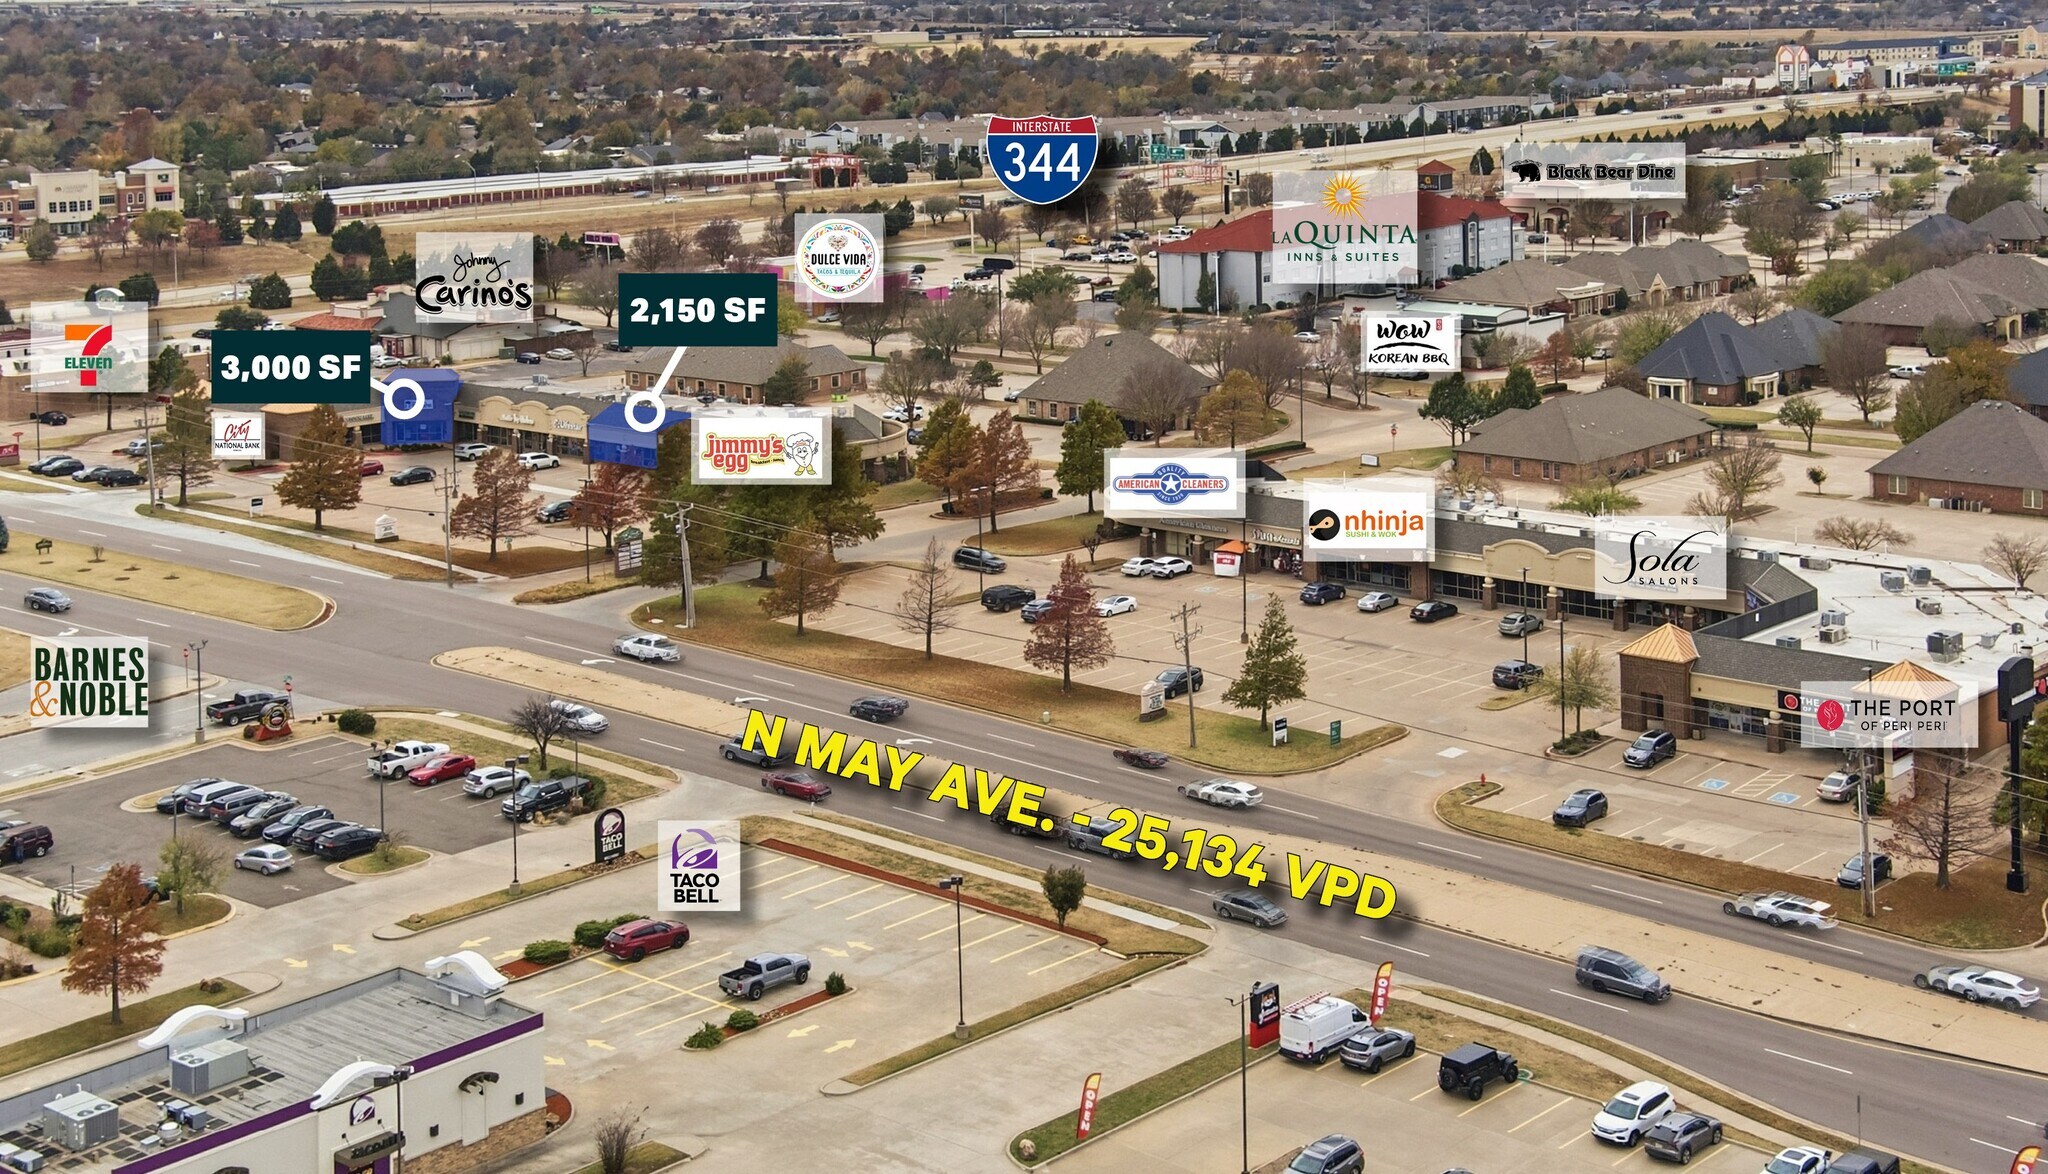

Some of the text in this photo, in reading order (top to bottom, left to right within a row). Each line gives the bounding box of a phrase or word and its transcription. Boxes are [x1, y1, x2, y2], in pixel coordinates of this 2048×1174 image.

[601, 833, 623, 844] TACO
[602, 840, 623, 852] BELL
[1374, 978, 1389, 1016] OPEN
[1081, 1089, 1096, 1131] OPEN
